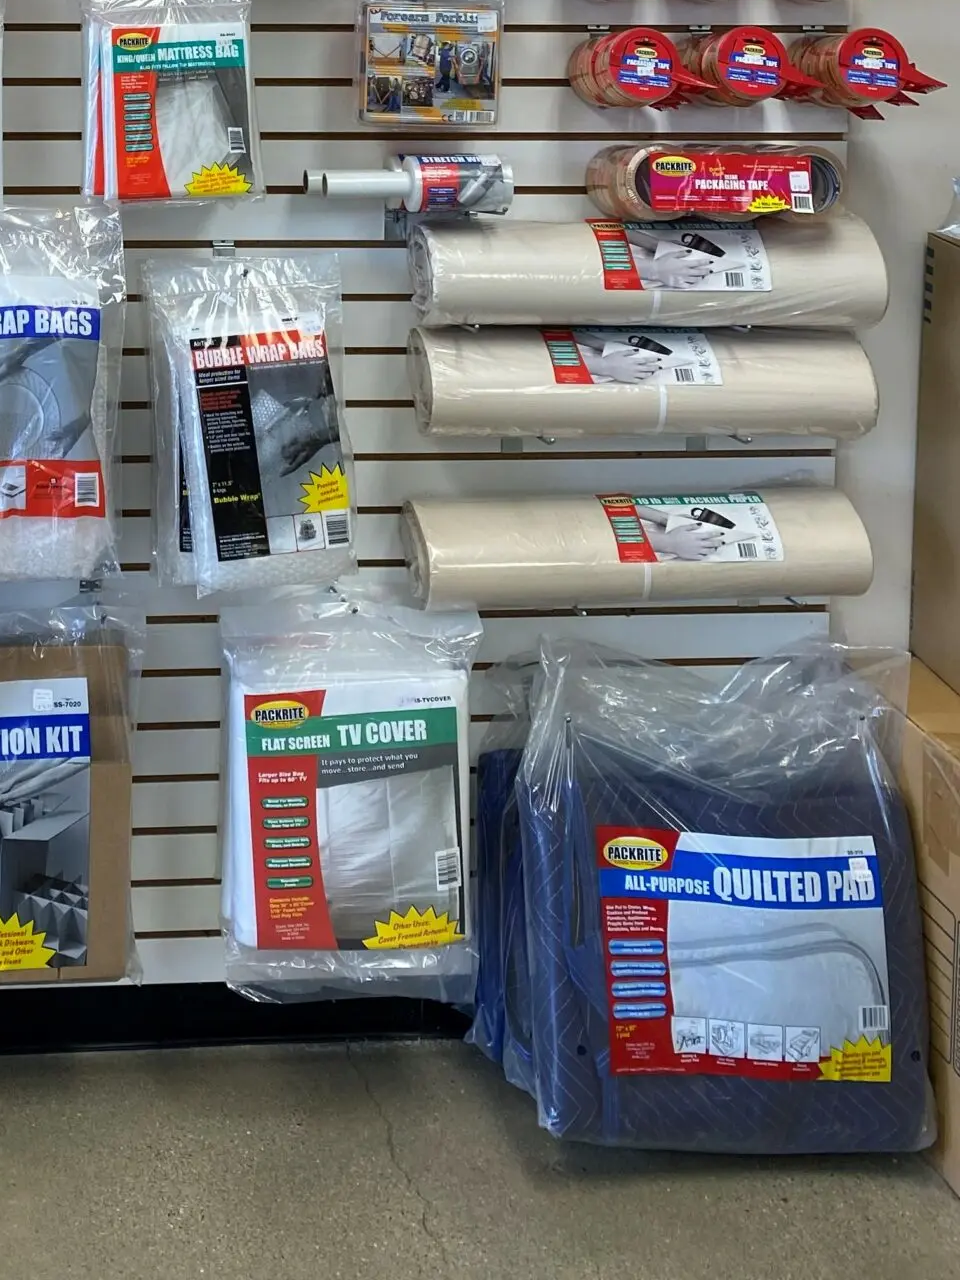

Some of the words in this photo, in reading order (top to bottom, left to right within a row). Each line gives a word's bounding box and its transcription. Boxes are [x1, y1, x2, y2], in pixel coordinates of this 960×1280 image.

[120, 37, 149, 46] PACKRITE
[158, 45, 213, 61] MATTRESS
[215, 44, 239, 59] BAG
[655, 162, 694, 172] PACKRITE
[695, 179, 746, 191] PACKAGING
[747, 179, 769, 191] TAPE
[34, 309, 93, 336] BAGS
[193, 347, 245, 370] BUBBLE
[246, 342, 286, 364] WRAP
[255, 707, 304, 722] PACKRITE
[45, 726, 83, 754] KIT
[261, 738, 287, 752] FLAT
[288, 734, 331, 750] SCREEN
[336, 724, 361, 746] TV
[364, 720, 427, 745] COVER
[329, 758, 347, 767] pays
[348, 757, 356, 765] to
[357, 755, 383, 765] protect
[384, 753, 403, 761] what
[404, 753, 418, 761] you
[607, 846, 662, 861] PACKRITE
[624, 874, 711, 896] ALL-PURPOSE
[713, 866, 822, 902] QUILTED
[828, 871, 876, 901] PAD
